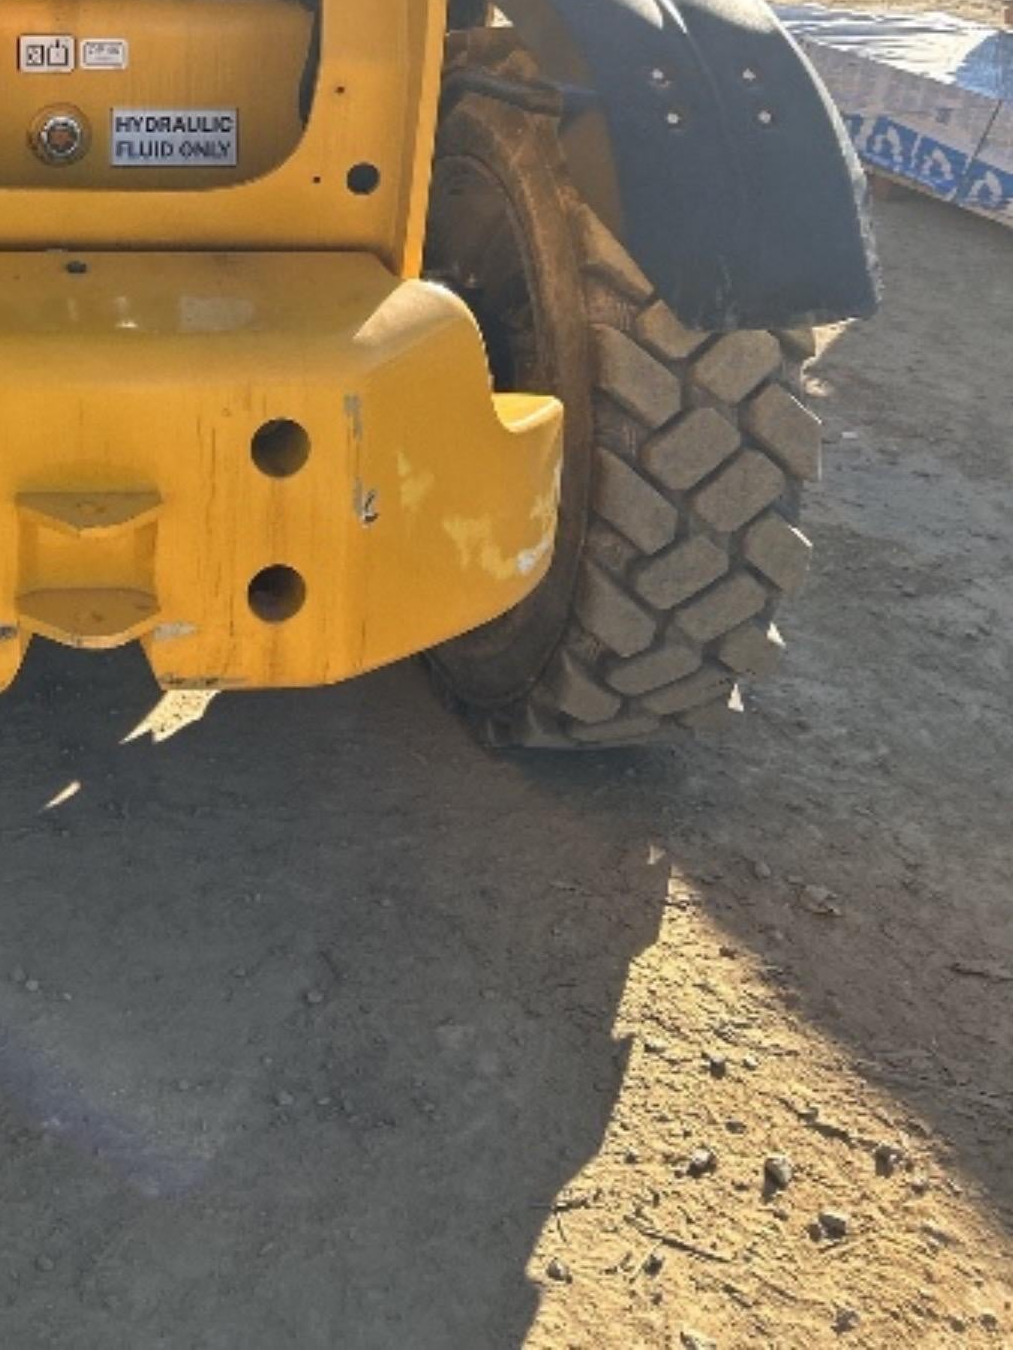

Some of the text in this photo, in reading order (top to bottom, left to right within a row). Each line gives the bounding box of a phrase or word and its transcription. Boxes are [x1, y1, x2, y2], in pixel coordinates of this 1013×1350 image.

[115, 116, 232, 133] HYDRAULIC
[115, 139, 231, 159] FLUID ONLY
